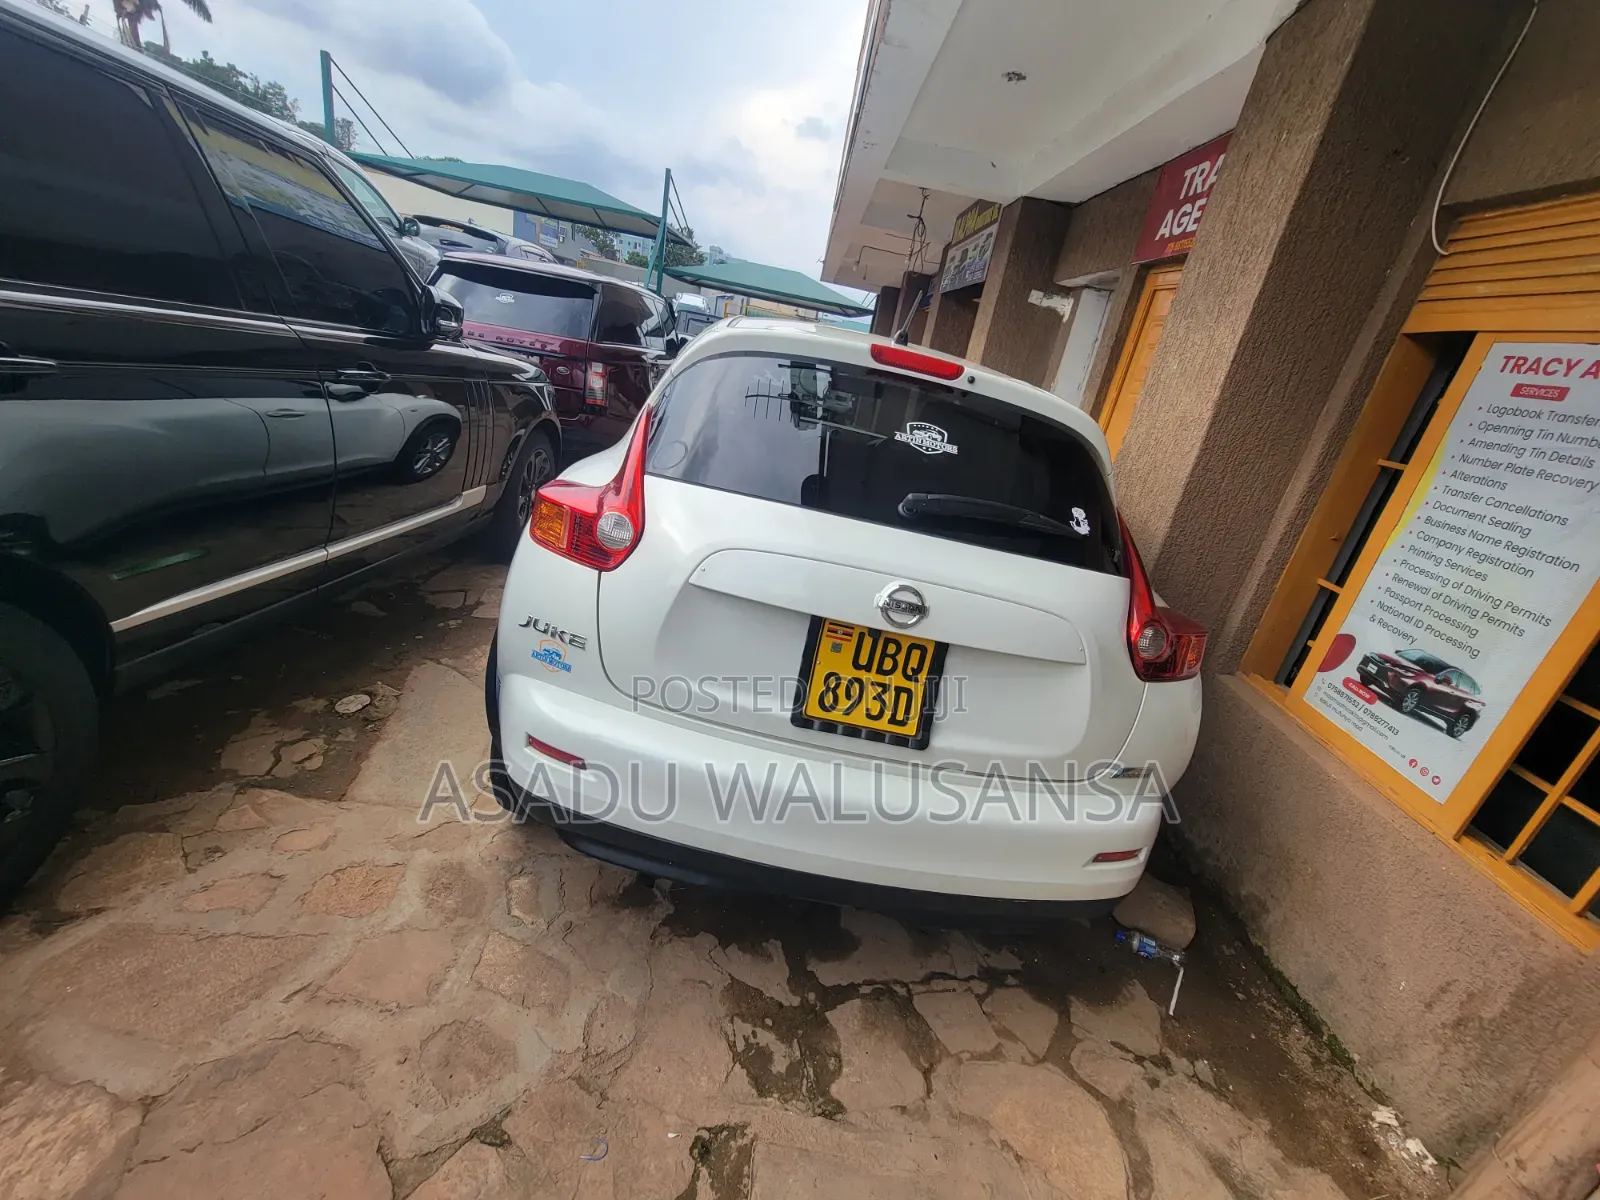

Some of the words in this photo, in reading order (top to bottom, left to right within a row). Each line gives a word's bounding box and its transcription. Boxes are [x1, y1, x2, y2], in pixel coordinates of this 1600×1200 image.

[1155, 198, 1207, 241] AGE
[496, 336, 548, 350] ROVER
[1500, 355, 1584, 378] TRACY
[1519, 386, 1560, 398] SERVICES
[1477, 420, 1534, 441] Openning
[1536, 428, 1555, 441] Tin
[1486, 403, 1544, 420] Logobook
[1547, 410, 1600, 427] Transfer
[894, 430, 922, 446] ARTIN
[920, 437, 958, 454] MOTORS
[1468, 437, 1526, 459] Amending
[1529, 447, 1547, 460] Tin
[1548, 450, 1596, 469] Details
[1449, 469, 1508, 491] Alterations
[1458, 453, 1504, 470] Number
[1503, 462, 1535, 478] Plate
[1536, 468, 1600, 494] Recovery
[1432, 500, 1488, 524] Document
[1487, 516, 1532, 540] Sealing
[1442, 485, 1485, 504] Transfer
[1485, 496, 1569, 527] Cancellations
[1408, 544, 1444, 566] Printing
[1444, 558, 1489, 582] Services
[1416, 530, 1467, 556] Company
[1466, 547, 1535, 579] Registration
[1424, 515, 1468, 536] Business
[1468, 529, 1503, 548] Name
[1503, 540, 1580, 573] Registration
[883, 599, 927, 616] NISSAN
[1384, 586, 1426, 612] Passport
[1423, 604, 1480, 639] Processing
[1391, 572, 1431, 596] Renewal
[1431, 589, 1444, 601] of
[1442, 595, 1480, 620] Driving
[1479, 610, 1526, 638] Permits
[1400, 559, 1450, 588] Processing
[1451, 579, 1465, 591] of
[1463, 584, 1503, 610] Driving
[1503, 600, 1552, 628] Permits
[518, 614, 588, 651] JUKE
[1369, 613, 1377, 624] &
[1376, 616, 1418, 646] Recovery
[1376, 600, 1414, 625] National
[1413, 618, 1425, 630] ID
[1424, 623, 1480, 660] Processing
[851, 630, 928, 684] UBQ
[817, 671, 914, 728] 893D
[1348, 682, 1360, 693] CALL
